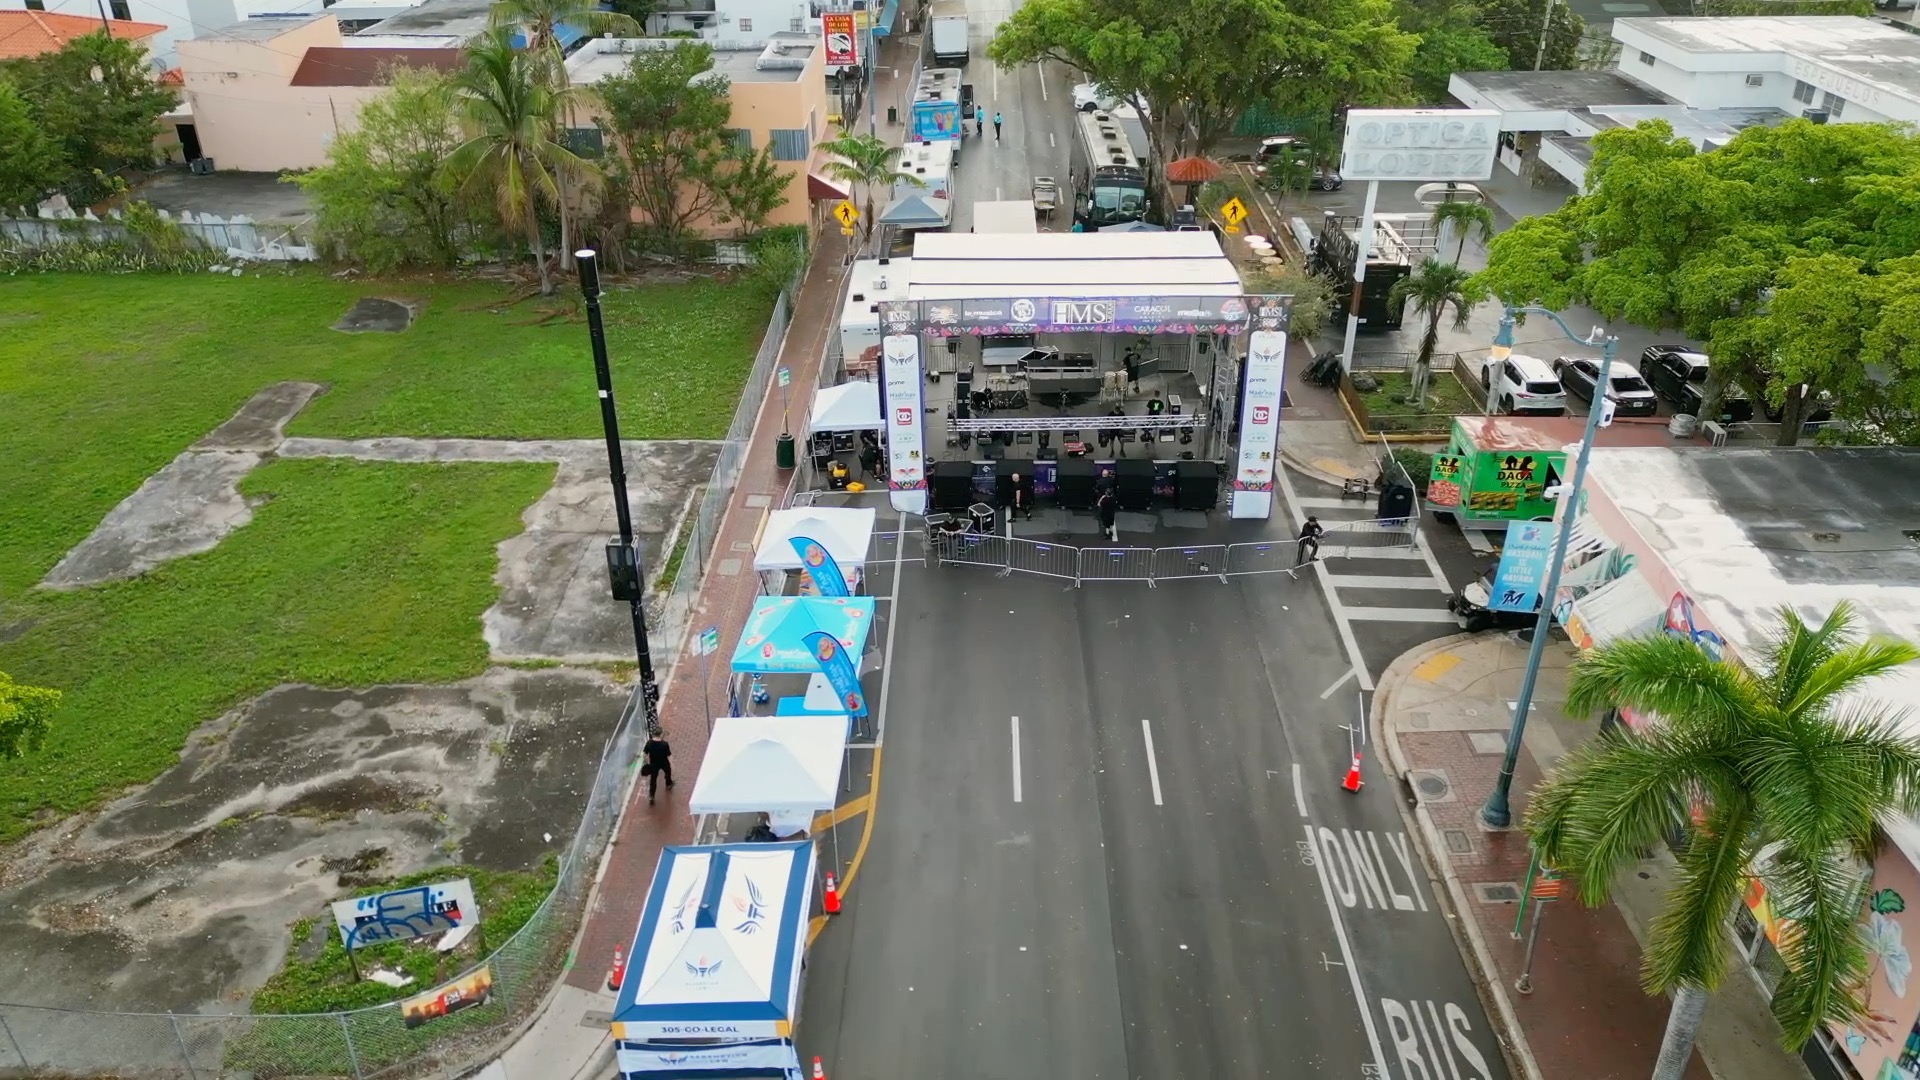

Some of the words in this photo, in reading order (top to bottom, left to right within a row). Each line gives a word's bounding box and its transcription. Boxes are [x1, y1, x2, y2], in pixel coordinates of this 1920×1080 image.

[1357, 122, 1487, 144] OPTICA
[1353, 153, 1486, 175] LOPEZ
[1053, 303, 1106, 324] HMS
[1501, 481, 1526, 489] PIZZA
[1319, 826, 1428, 912] ONLY
